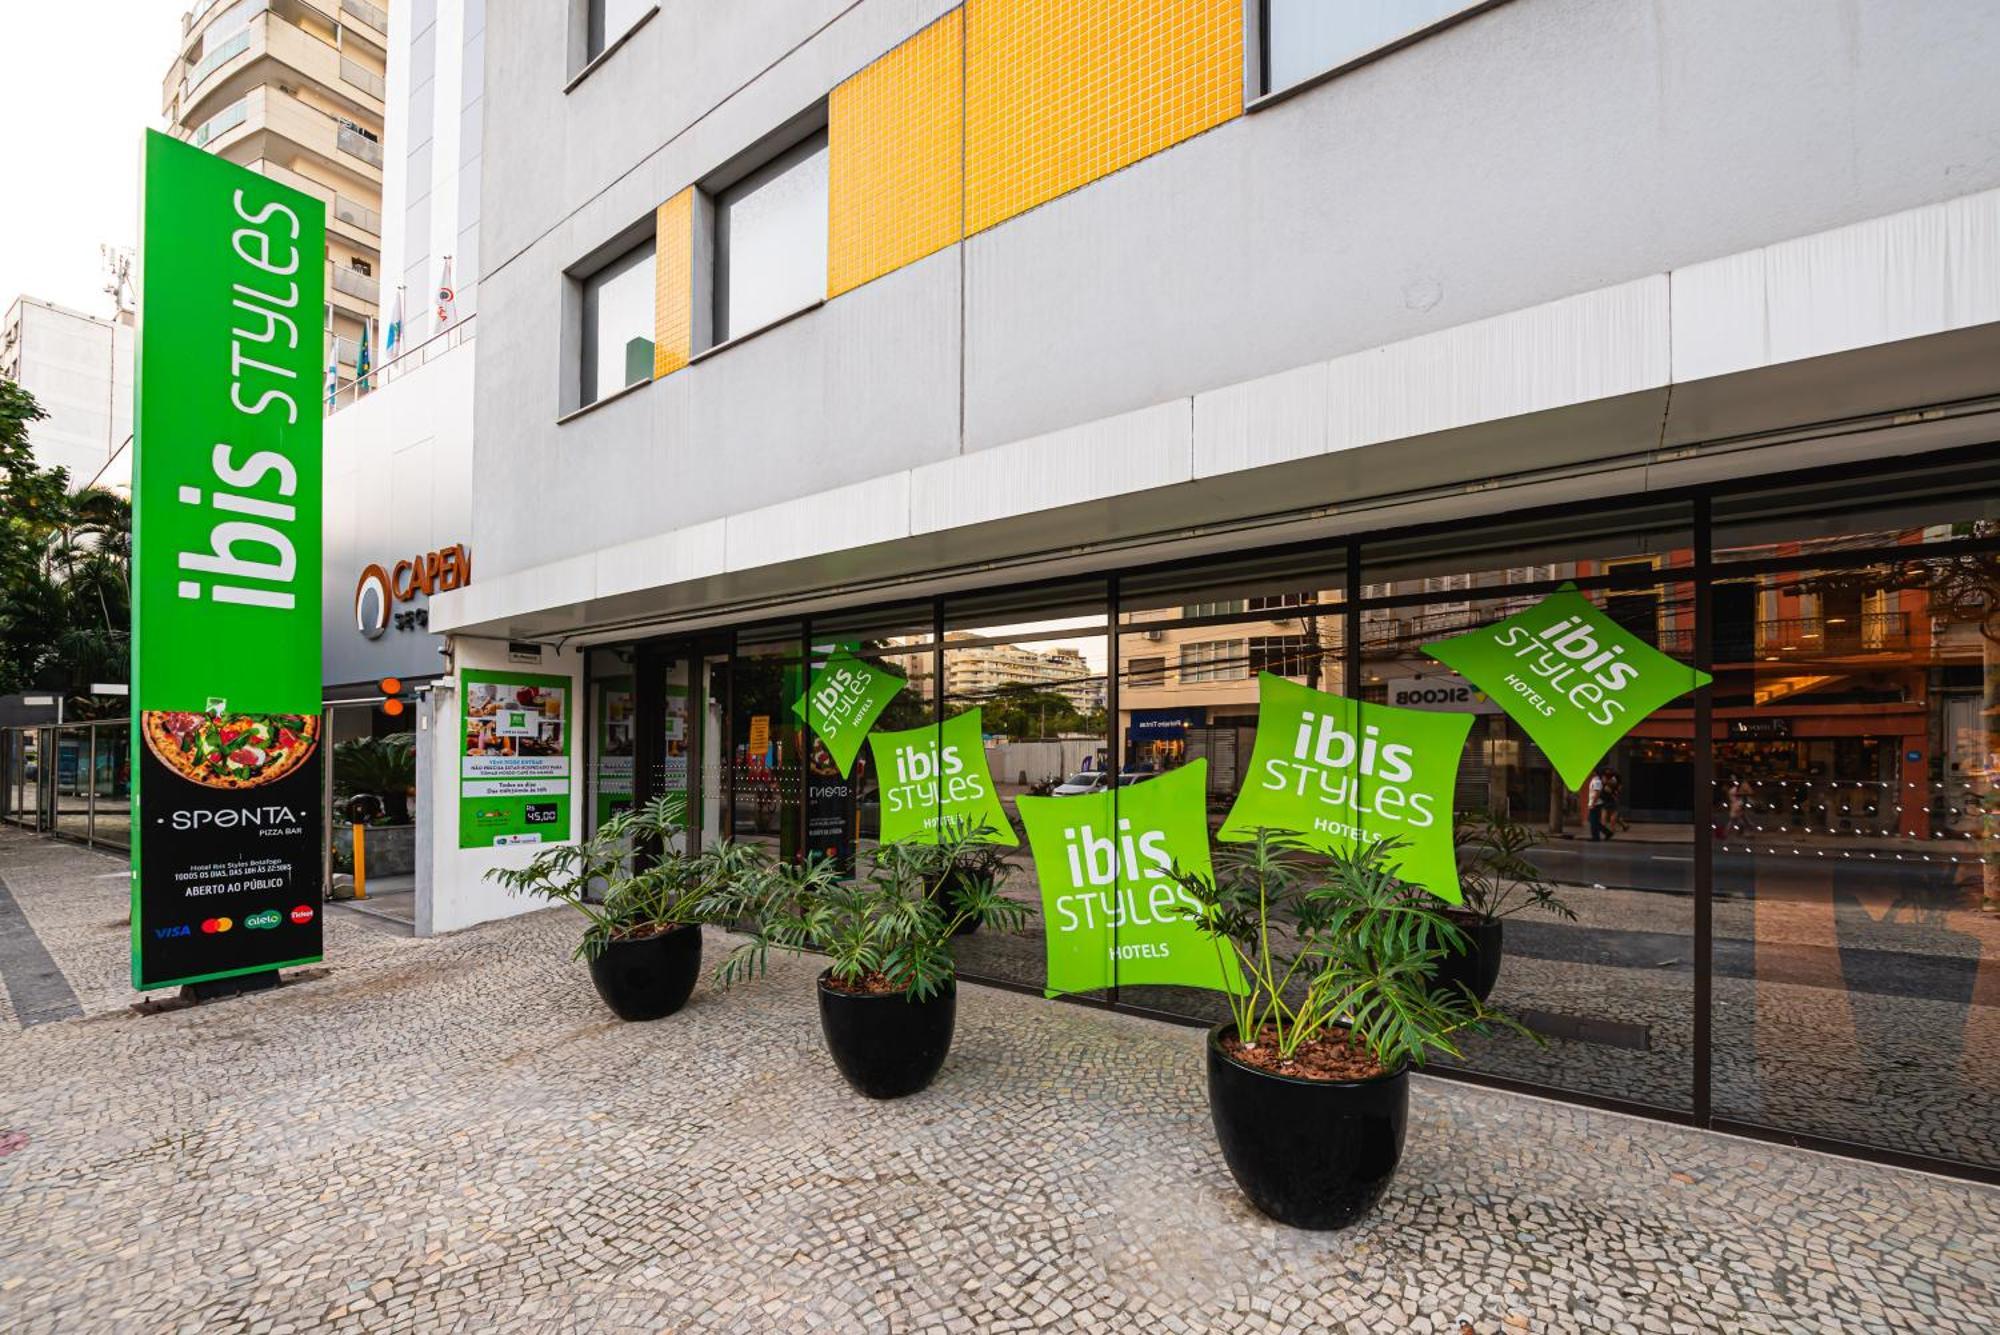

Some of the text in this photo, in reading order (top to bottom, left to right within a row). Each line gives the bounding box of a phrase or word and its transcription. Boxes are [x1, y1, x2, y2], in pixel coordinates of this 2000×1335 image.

[178, 443, 298, 609] ibis
[1538, 615, 1640, 690] ibis
[812, 668, 852, 717] ibis
[1503, 673, 1556, 717] HOTELS
[1294, 711, 1414, 783] ibis
[895, 741, 963, 783] ibis
[527, 811, 556, 822] 45,00
[259, 827, 302, 837] PIZZA BAR
[1313, 817, 1383, 846] HOTELS
[190, 863, 212, 871] Hotel
[227, 861, 249, 869] Styles
[1064, 818, 1171, 888] ibis
[175, 871, 198, 881] TODOS
[199, 870, 209, 879] OS
[228, 868, 243, 876] DAS
[185, 877, 284, 897] ABERTO AO PÚBLICO
[155, 925, 192, 940] VISA
[1109, 942, 1170, 961] HOTELS
